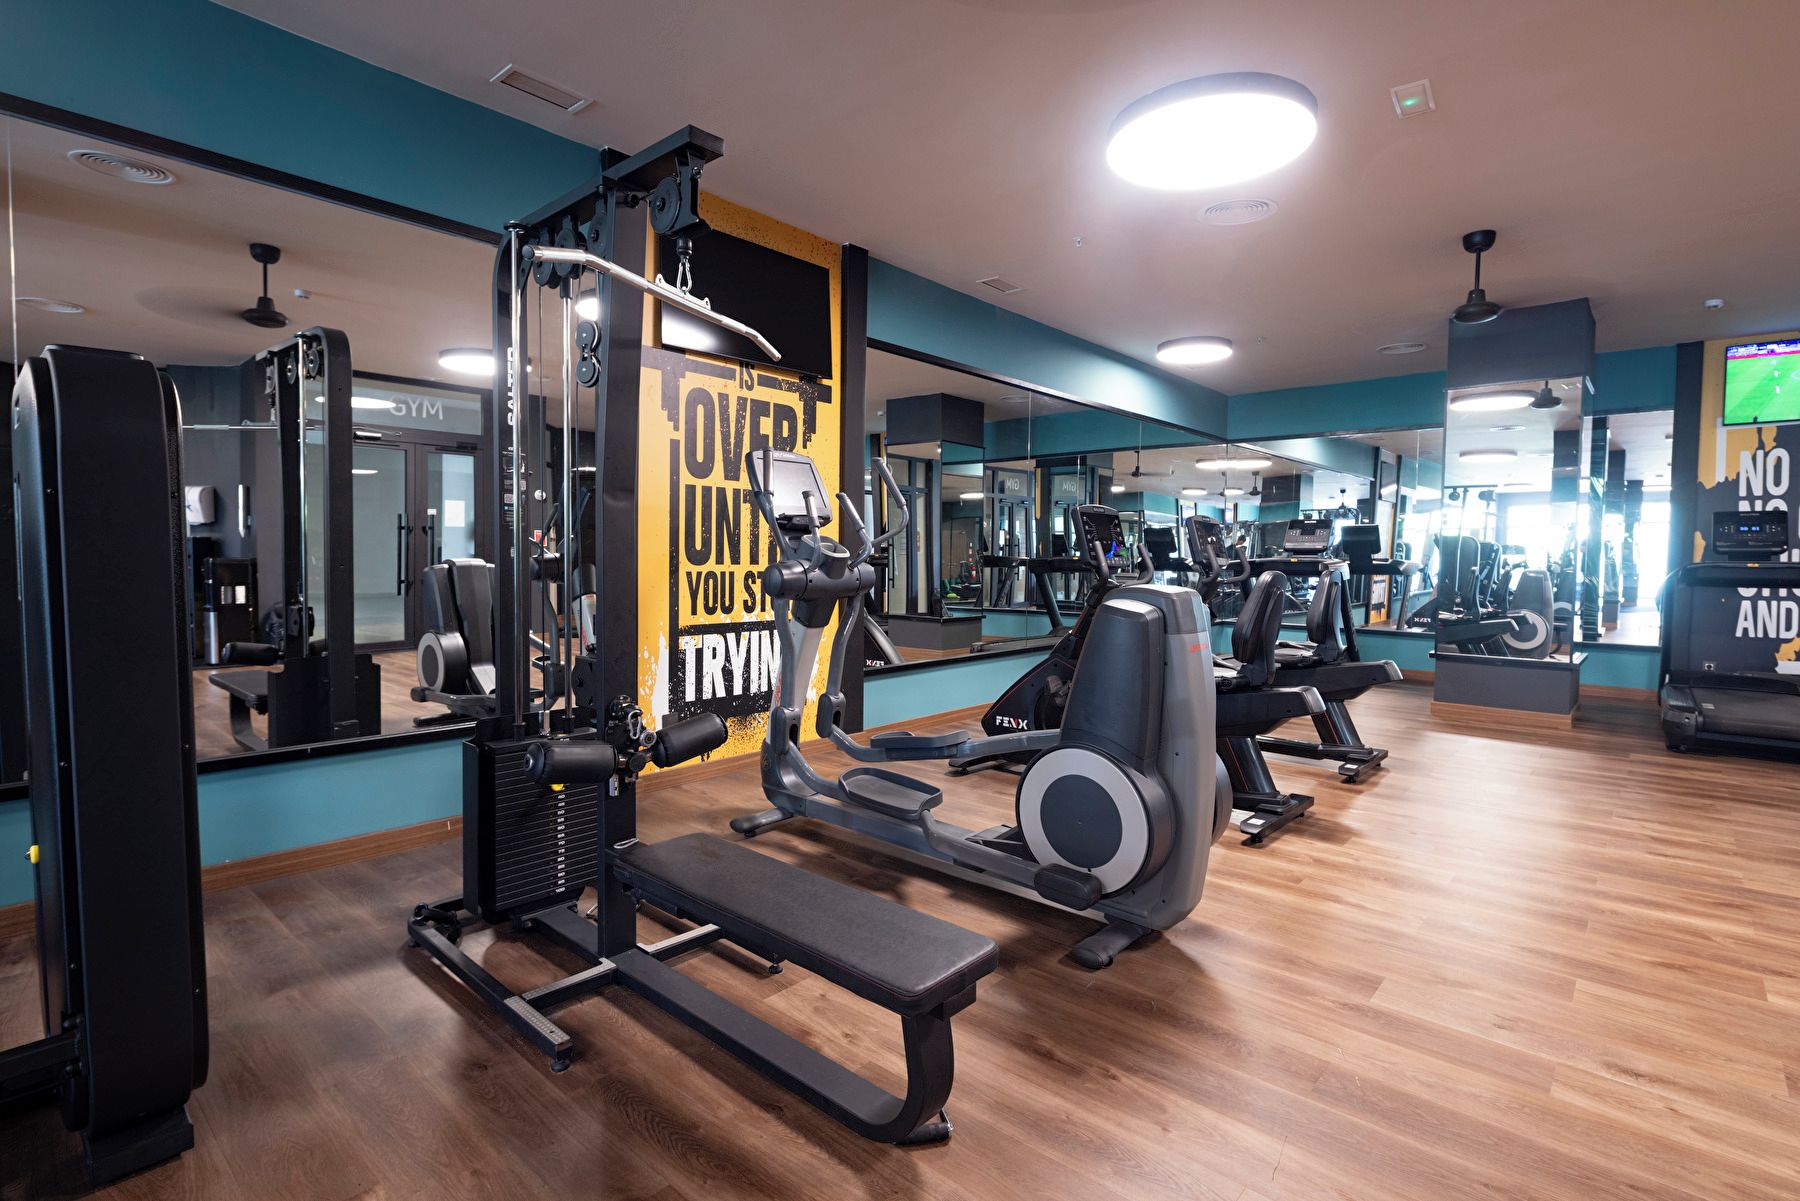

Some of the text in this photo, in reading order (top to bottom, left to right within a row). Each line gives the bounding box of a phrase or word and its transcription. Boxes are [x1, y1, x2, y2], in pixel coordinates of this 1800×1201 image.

[390, 394, 443, 420] GYM
[1738, 447, 1790, 497] NO
[684, 484, 778, 566] UNT
[685, 570, 776, 616] YOU ST
[1735, 600, 1800, 639] AND
[678, 629, 781, 703] TRYIN
[995, 715, 1028, 730] FENX
